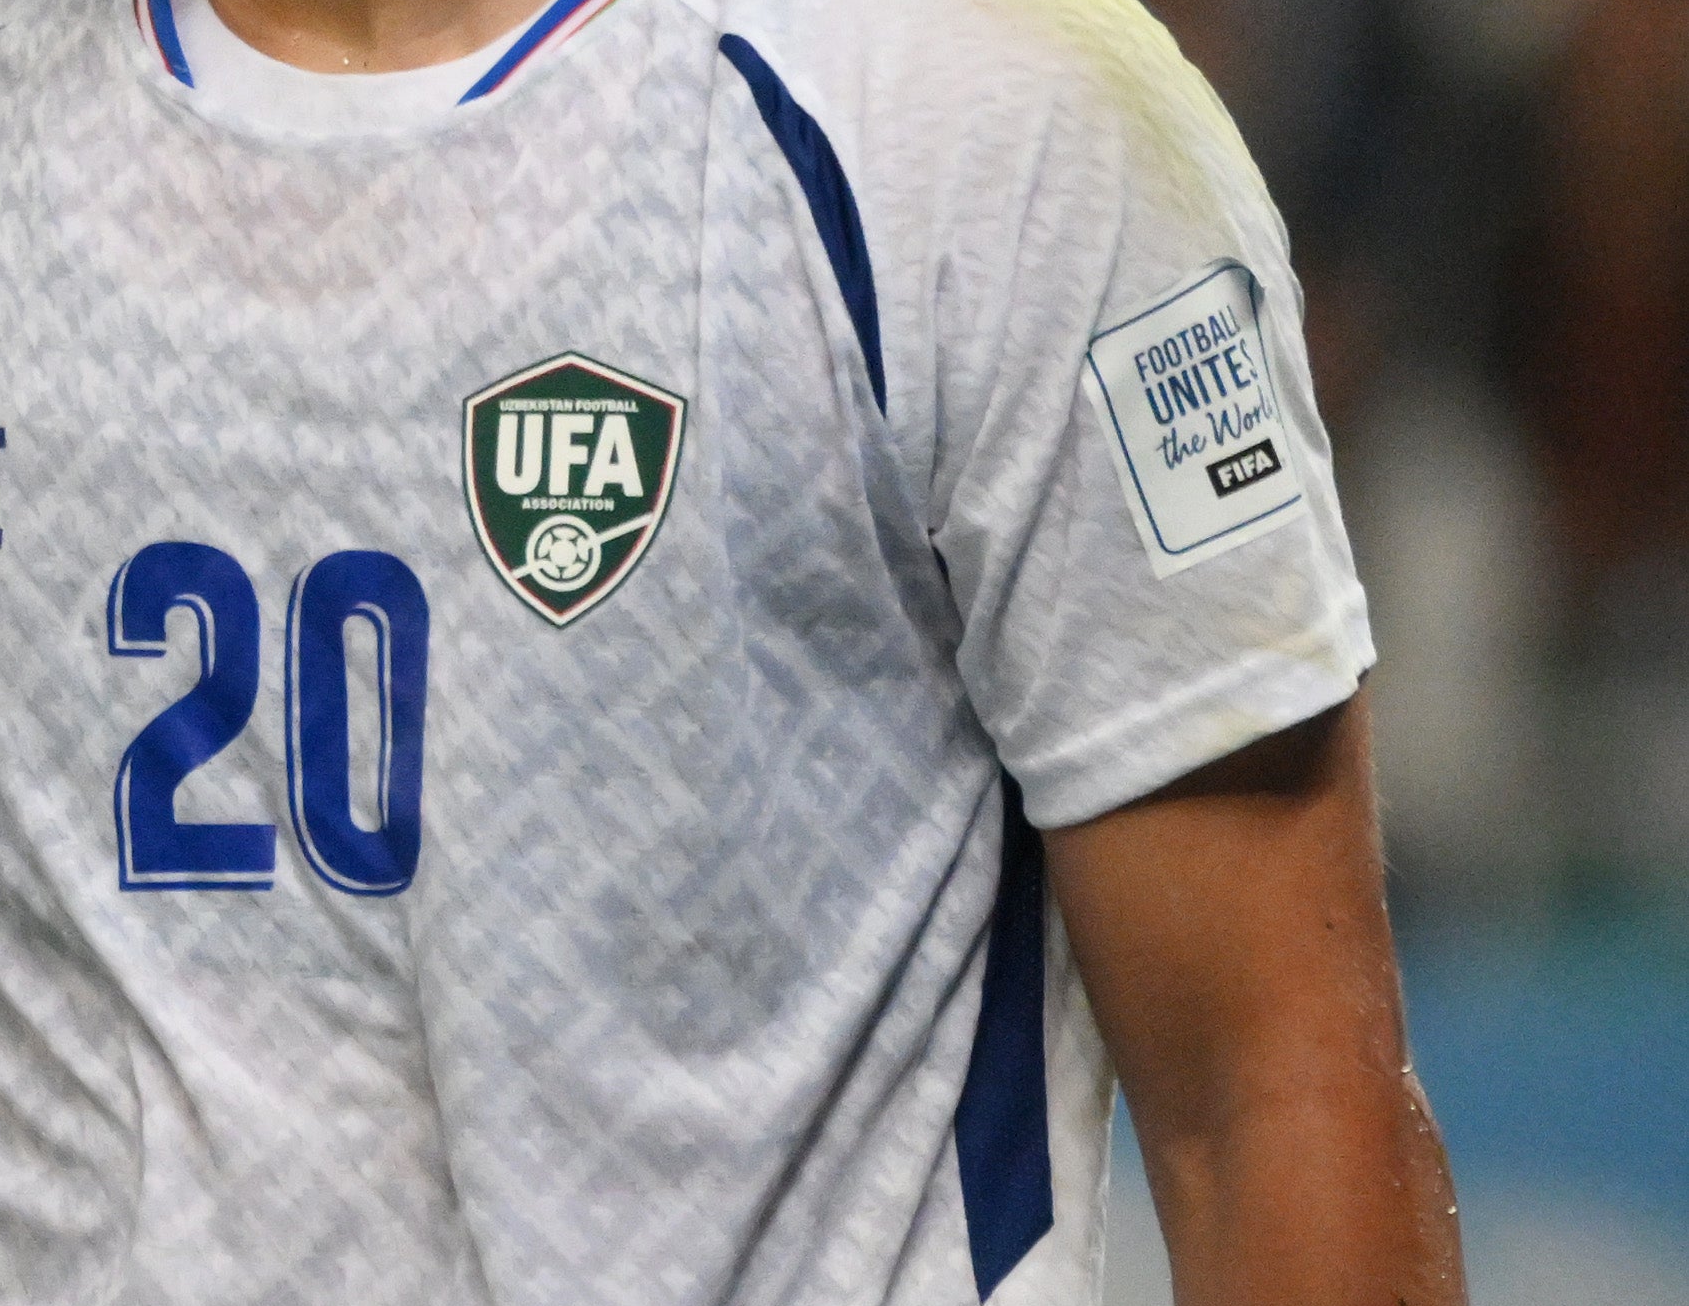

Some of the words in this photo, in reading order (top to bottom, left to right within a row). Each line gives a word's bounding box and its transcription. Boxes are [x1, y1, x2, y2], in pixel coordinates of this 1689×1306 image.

[499, 398, 573, 412] UZBEKISTAN
[575, 399, 639, 413] FOOTBALL
[495, 413, 644, 497] UFA
[1156, 427, 1206, 470] the
[1217, 448, 1274, 488] FIFA
[521, 497, 615, 511] ASSOCIATION
[107, 541, 430, 897] 20
